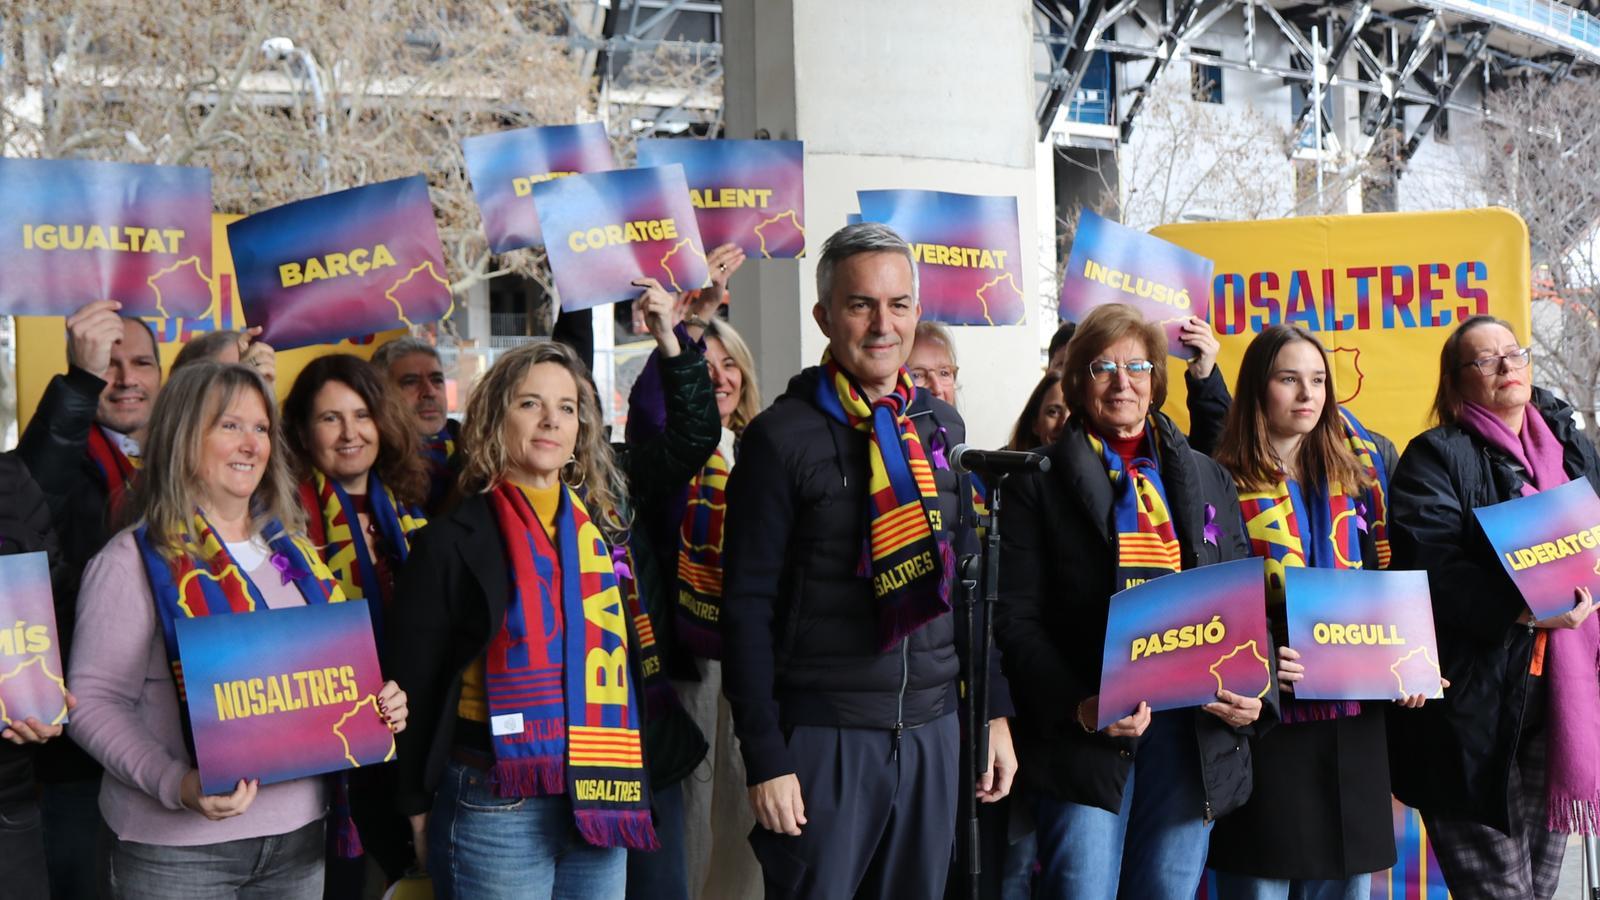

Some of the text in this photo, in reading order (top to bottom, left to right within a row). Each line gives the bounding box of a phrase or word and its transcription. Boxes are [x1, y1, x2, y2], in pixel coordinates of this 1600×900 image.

[23, 224, 184, 254] IGUALTAT
[568, 219, 678, 252] CORATGE
[280, 244, 396, 288] BARÇA
[1084, 259, 1191, 310] INCLUSIÓ
[1208, 260, 1489, 335] OSALTRES
[1131, 616, 1225, 661] PASSIÓ
[1313, 623, 1405, 645] ORGULL
[213, 665, 358, 721] NOSALTRES
[575, 779, 641, 802] NOSALTRES
